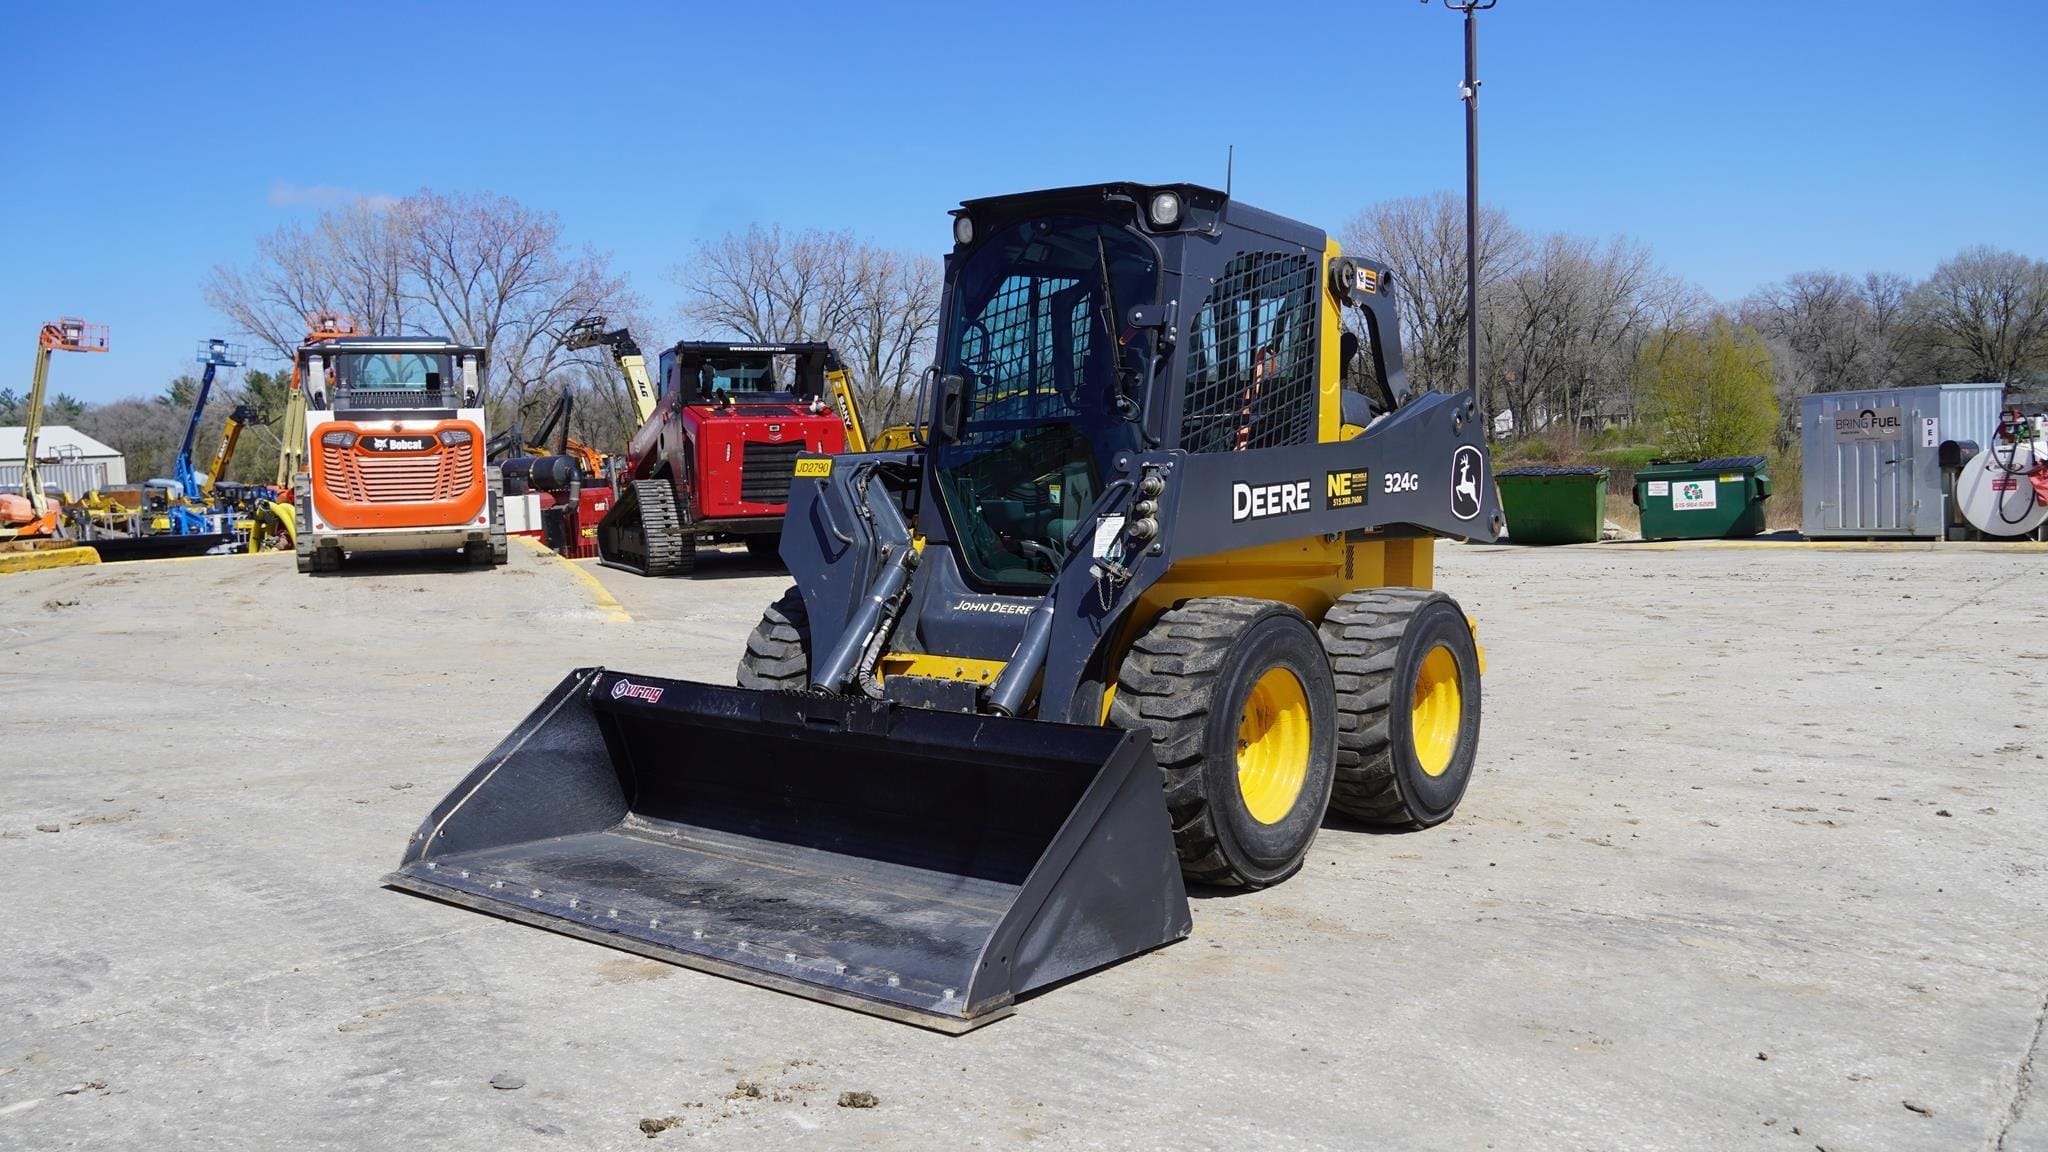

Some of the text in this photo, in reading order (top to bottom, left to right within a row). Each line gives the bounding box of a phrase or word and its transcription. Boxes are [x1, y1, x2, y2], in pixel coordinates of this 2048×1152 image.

[637, 379, 649, 398] JLG
[838, 395, 852, 426] SANY
[1836, 416, 1901, 430] BRING FUEL
[389, 439, 422, 450] Bobcat
[797, 462, 829, 473] JD2790
[1327, 472, 1352, 498] NE
[1384, 472, 1418, 494] 324G
[594, 502, 605, 511] CAT
[1233, 480, 1311, 521] DEERE
[953, 600, 990, 613] JOHN
